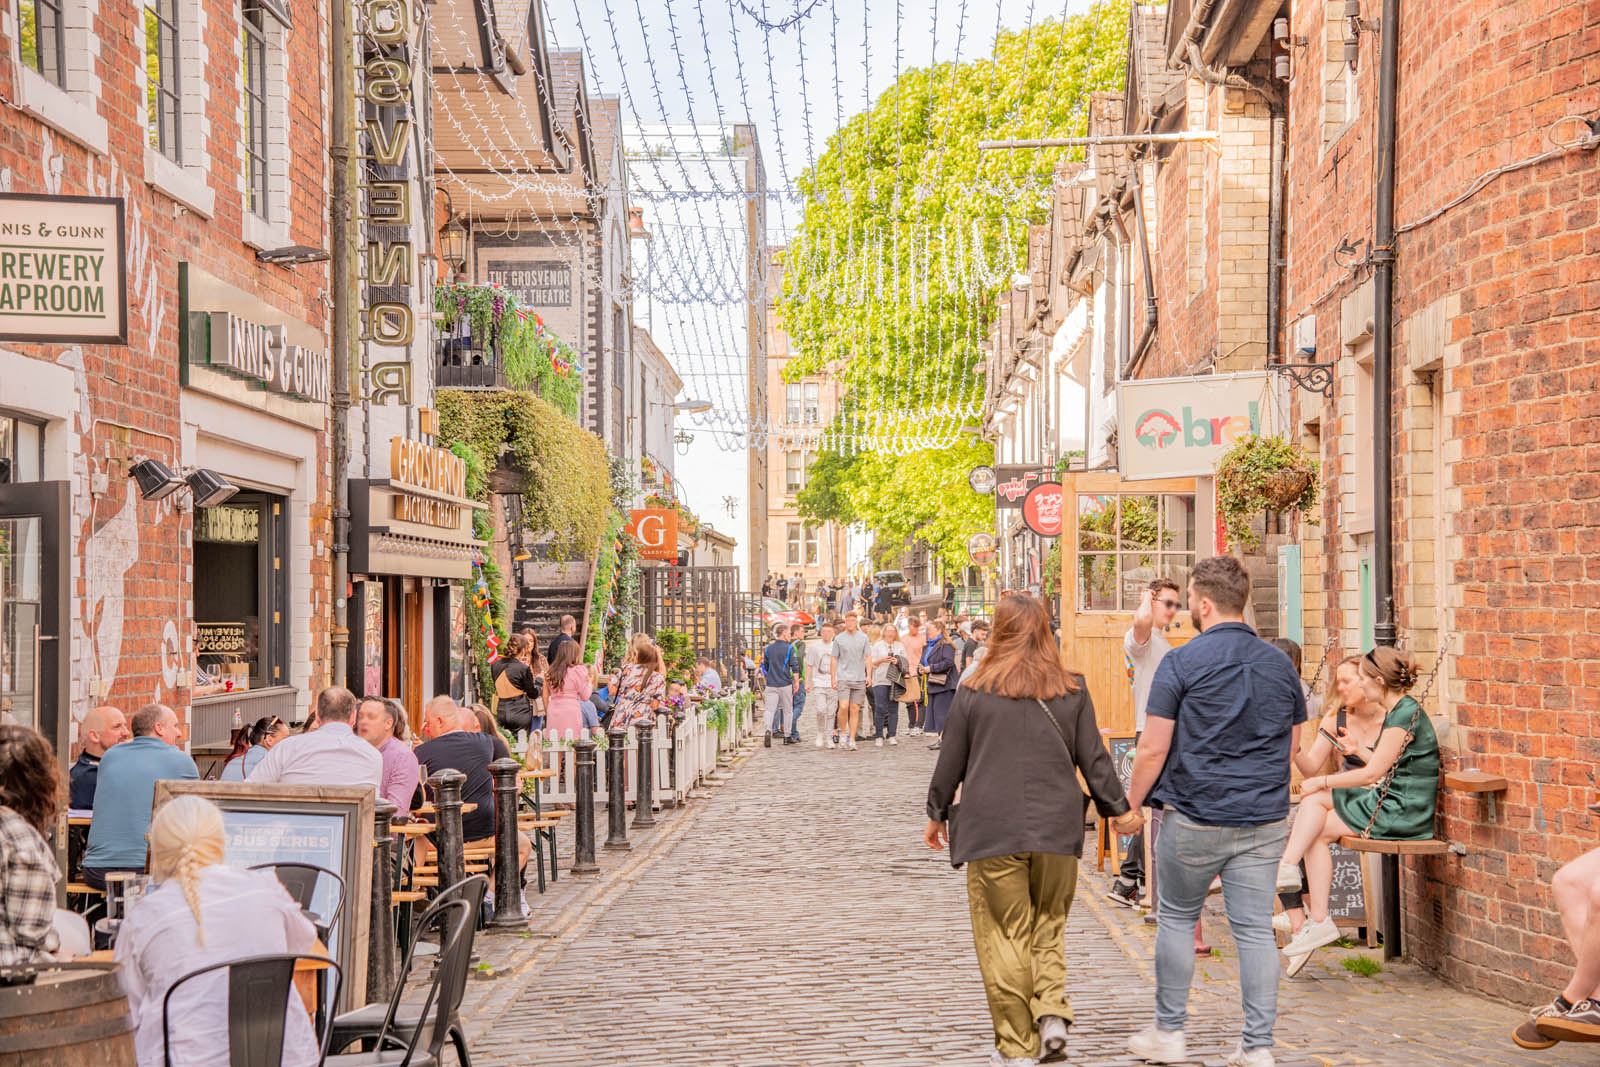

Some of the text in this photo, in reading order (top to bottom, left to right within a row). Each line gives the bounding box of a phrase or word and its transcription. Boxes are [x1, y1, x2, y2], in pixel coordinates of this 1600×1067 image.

[2, 222, 104, 239] NIS & GUNN
[1, 252, 104, 282] REWERY
[489, 270, 570, 287] THE GROSVENOR
[0, 283, 104, 313] APROOM
[530, 289, 570, 304] THEATRE
[227, 311, 329, 403] INNIS & GUNN
[1181, 400, 1259, 448] brel
[404, 495, 435, 525] PICTURE
[637, 515, 667, 546] G
